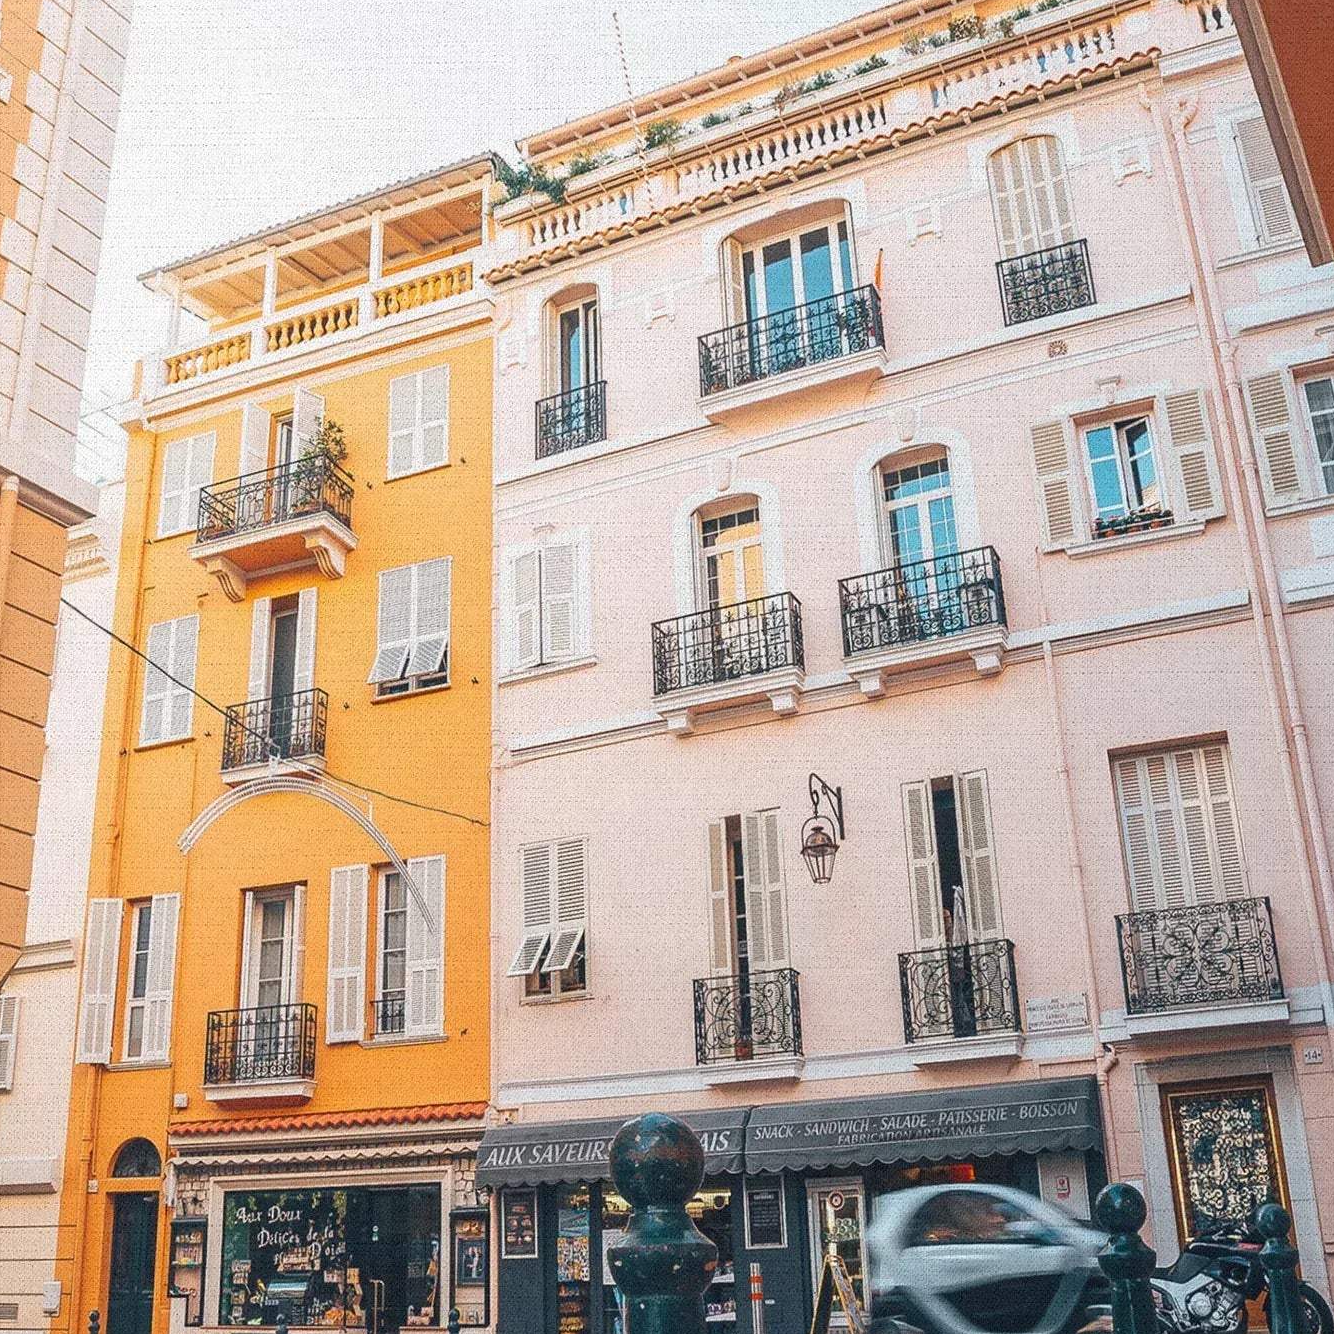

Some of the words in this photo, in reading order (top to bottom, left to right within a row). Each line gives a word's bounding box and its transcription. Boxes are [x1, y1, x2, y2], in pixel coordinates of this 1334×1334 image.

[754, 1124, 794, 1141] SNACK
[803, 1119, 869, 1137] SANDWICH
[880, 1114, 928, 1131] SALADE
[938, 1107, 1009, 1126] PATISSERIE
[1019, 1101, 1078, 1120] BOISSON
[483, 1146, 524, 1167] AUX
